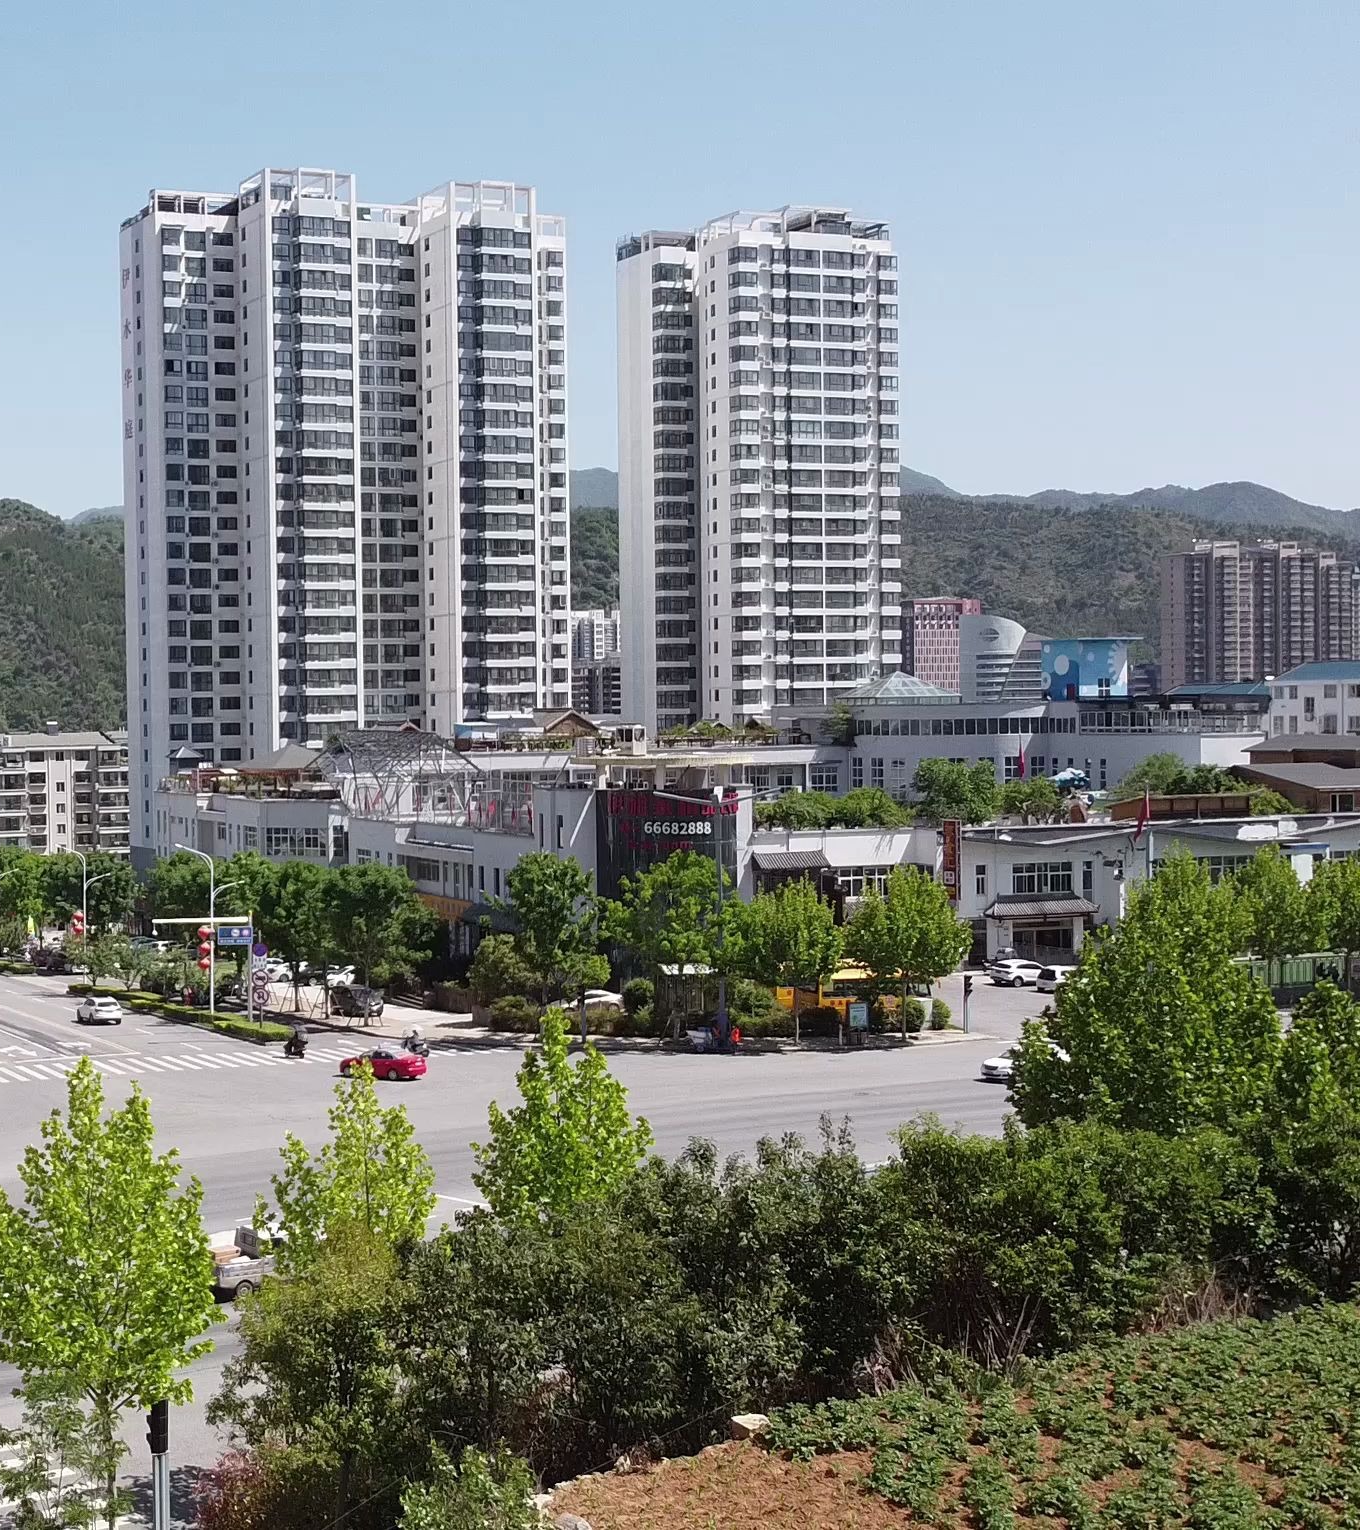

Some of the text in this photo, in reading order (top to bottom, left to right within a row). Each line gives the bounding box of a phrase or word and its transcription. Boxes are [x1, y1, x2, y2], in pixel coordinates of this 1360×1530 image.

[122, 268, 133, 439] 伊水华庭
[644, 821, 712, 835] 66682888
